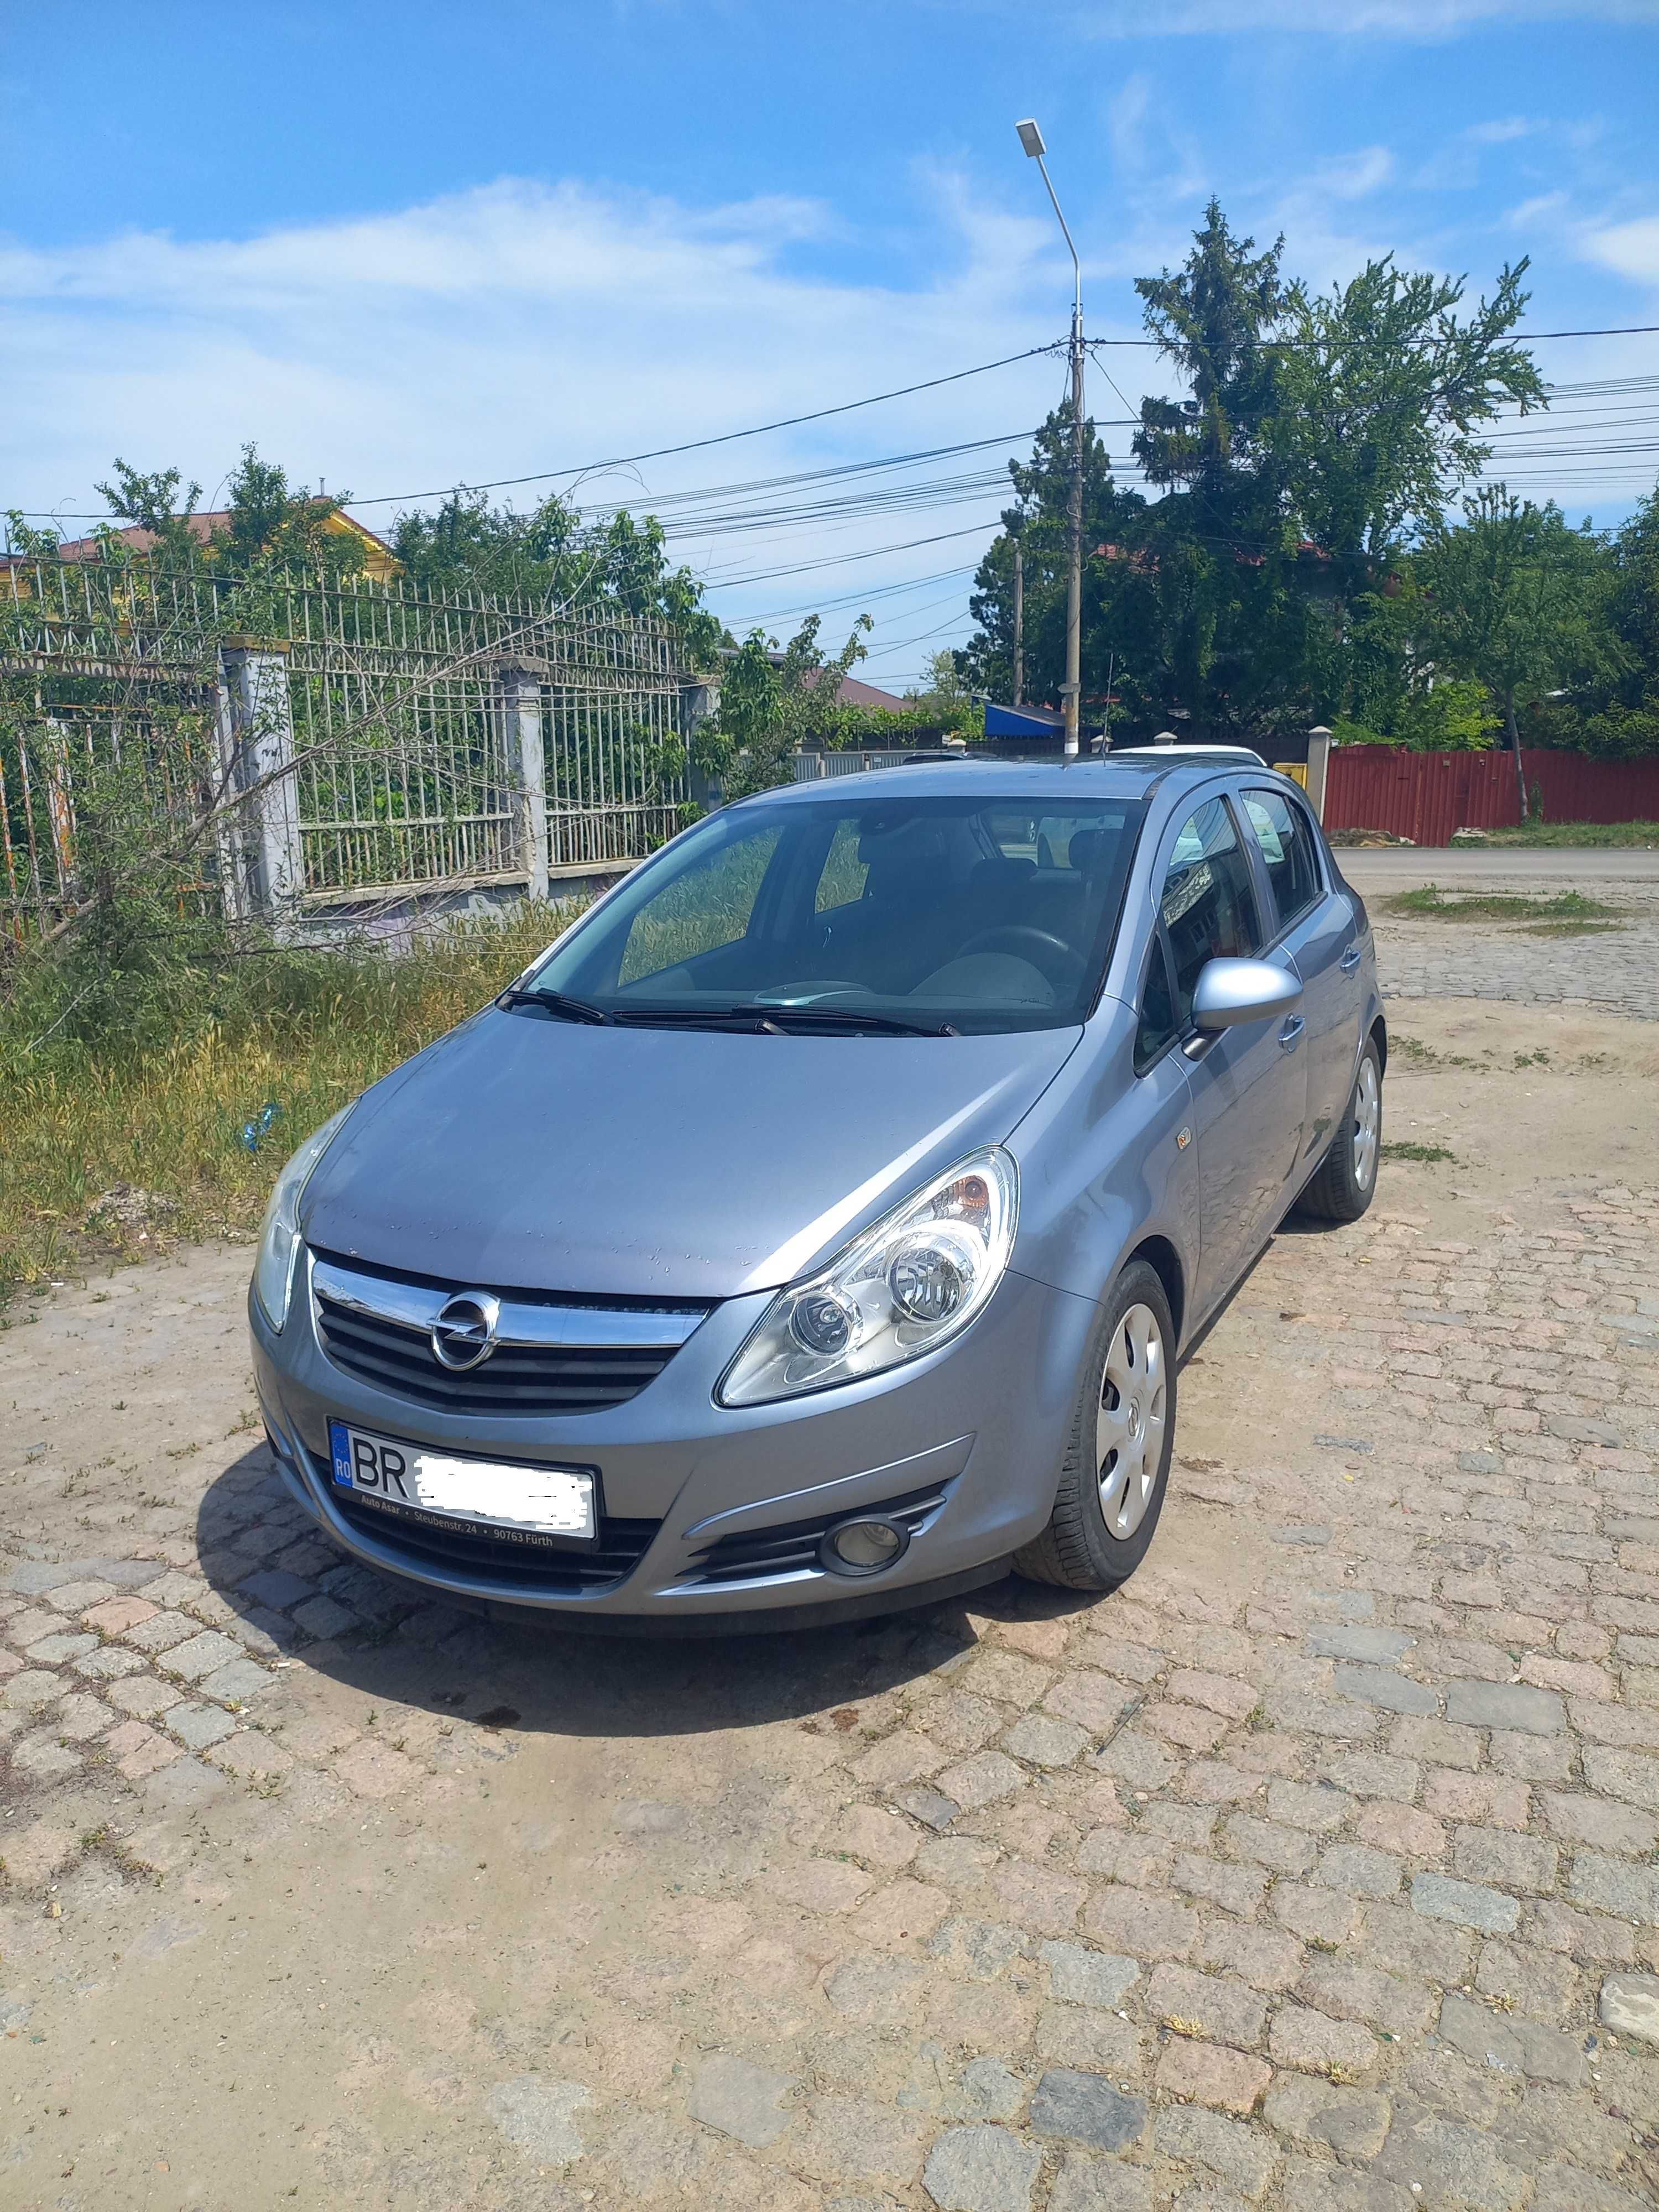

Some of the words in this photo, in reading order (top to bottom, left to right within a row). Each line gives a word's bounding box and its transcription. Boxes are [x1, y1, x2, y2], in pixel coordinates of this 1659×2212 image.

[336, 1458, 351, 1479] RO
[353, 1437, 409, 1499] BR
[362, 1495, 380, 1508] Auto
[382, 1504, 400, 1515] Asar
[415, 1511, 464, 1532] Steubenstr.
[466, 1524, 477, 1535] 24
[494, 1528, 523, 1542] 90763
[525, 1534, 554, 1547] Fürth
